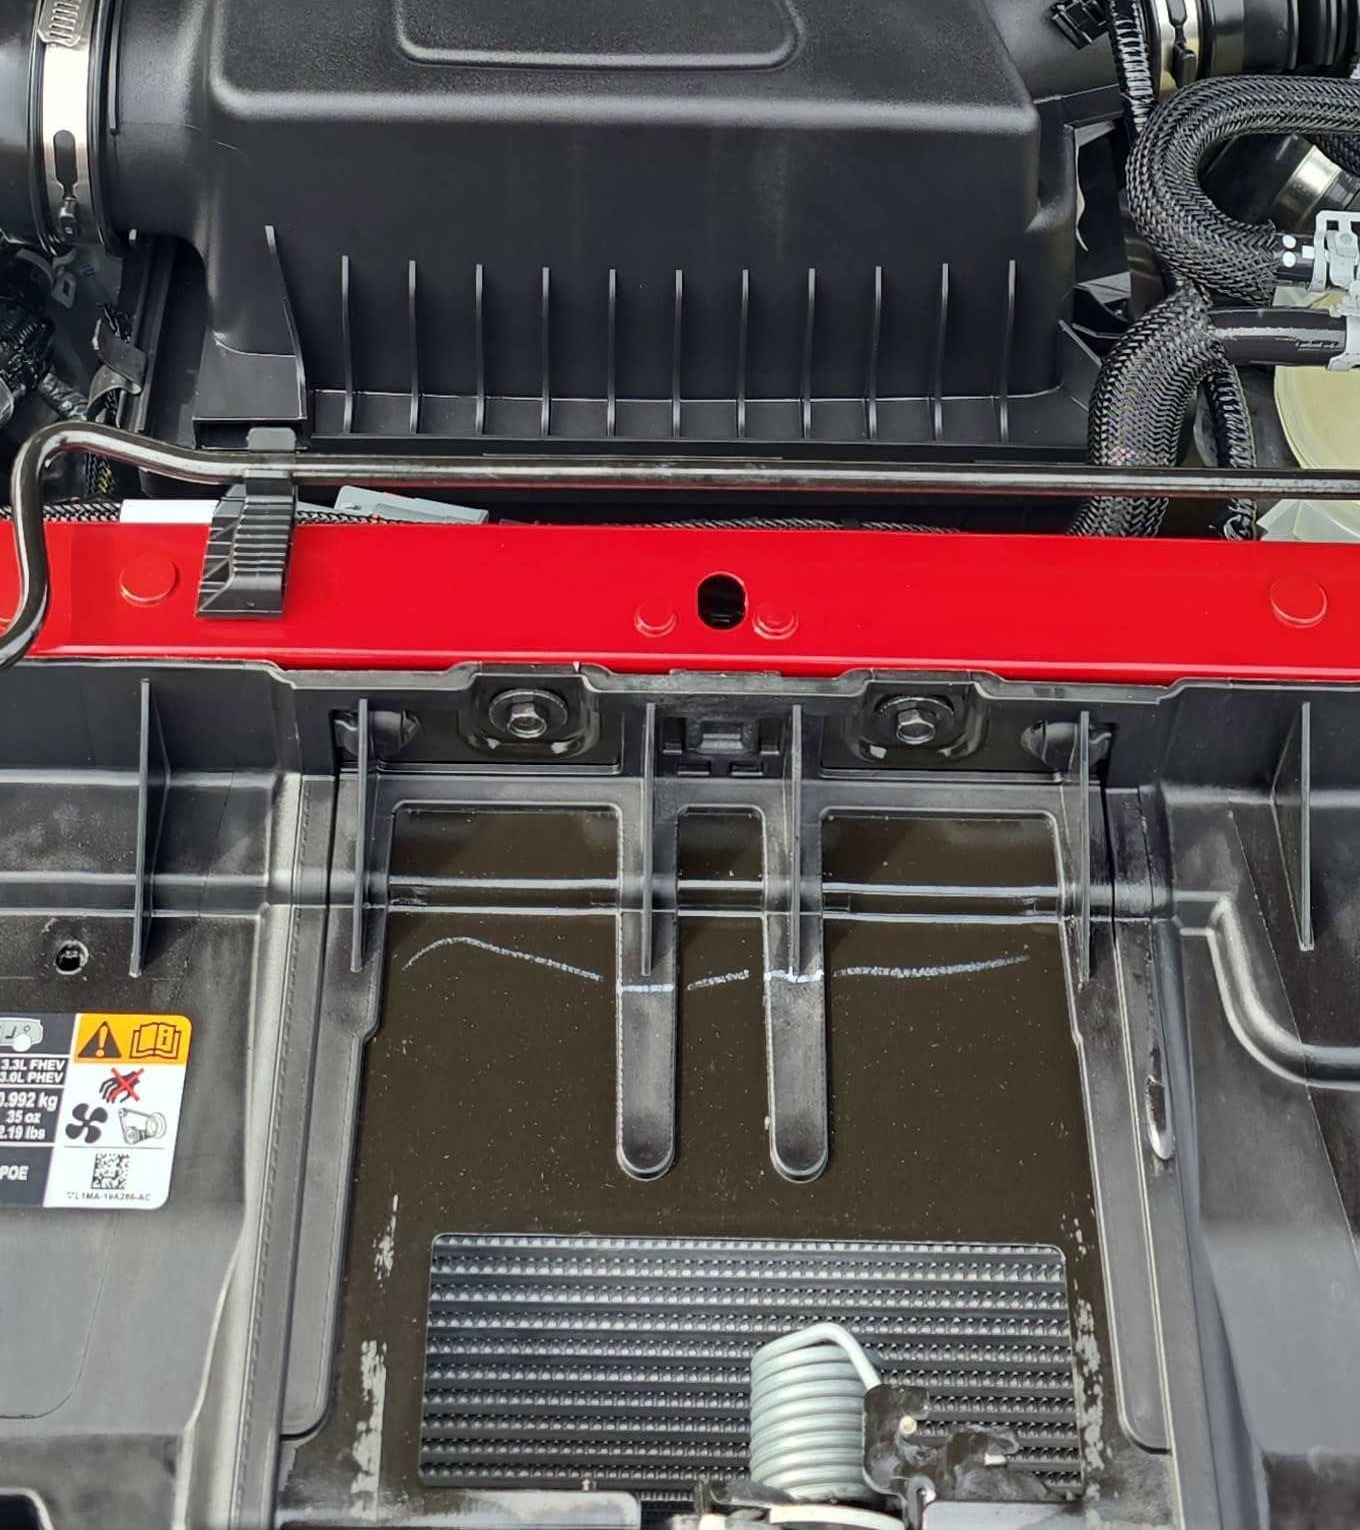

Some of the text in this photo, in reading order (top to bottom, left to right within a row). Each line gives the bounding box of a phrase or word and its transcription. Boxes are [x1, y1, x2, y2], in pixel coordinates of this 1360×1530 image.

[0, 1058, 67, 1072] 3.3L FHEV
[27, 1071, 65, 1084] PHEV
[38, 1091, 60, 1112] kg
[5, 1109, 42, 1124] 35 oz
[25, 1126, 47, 1141] lbs
